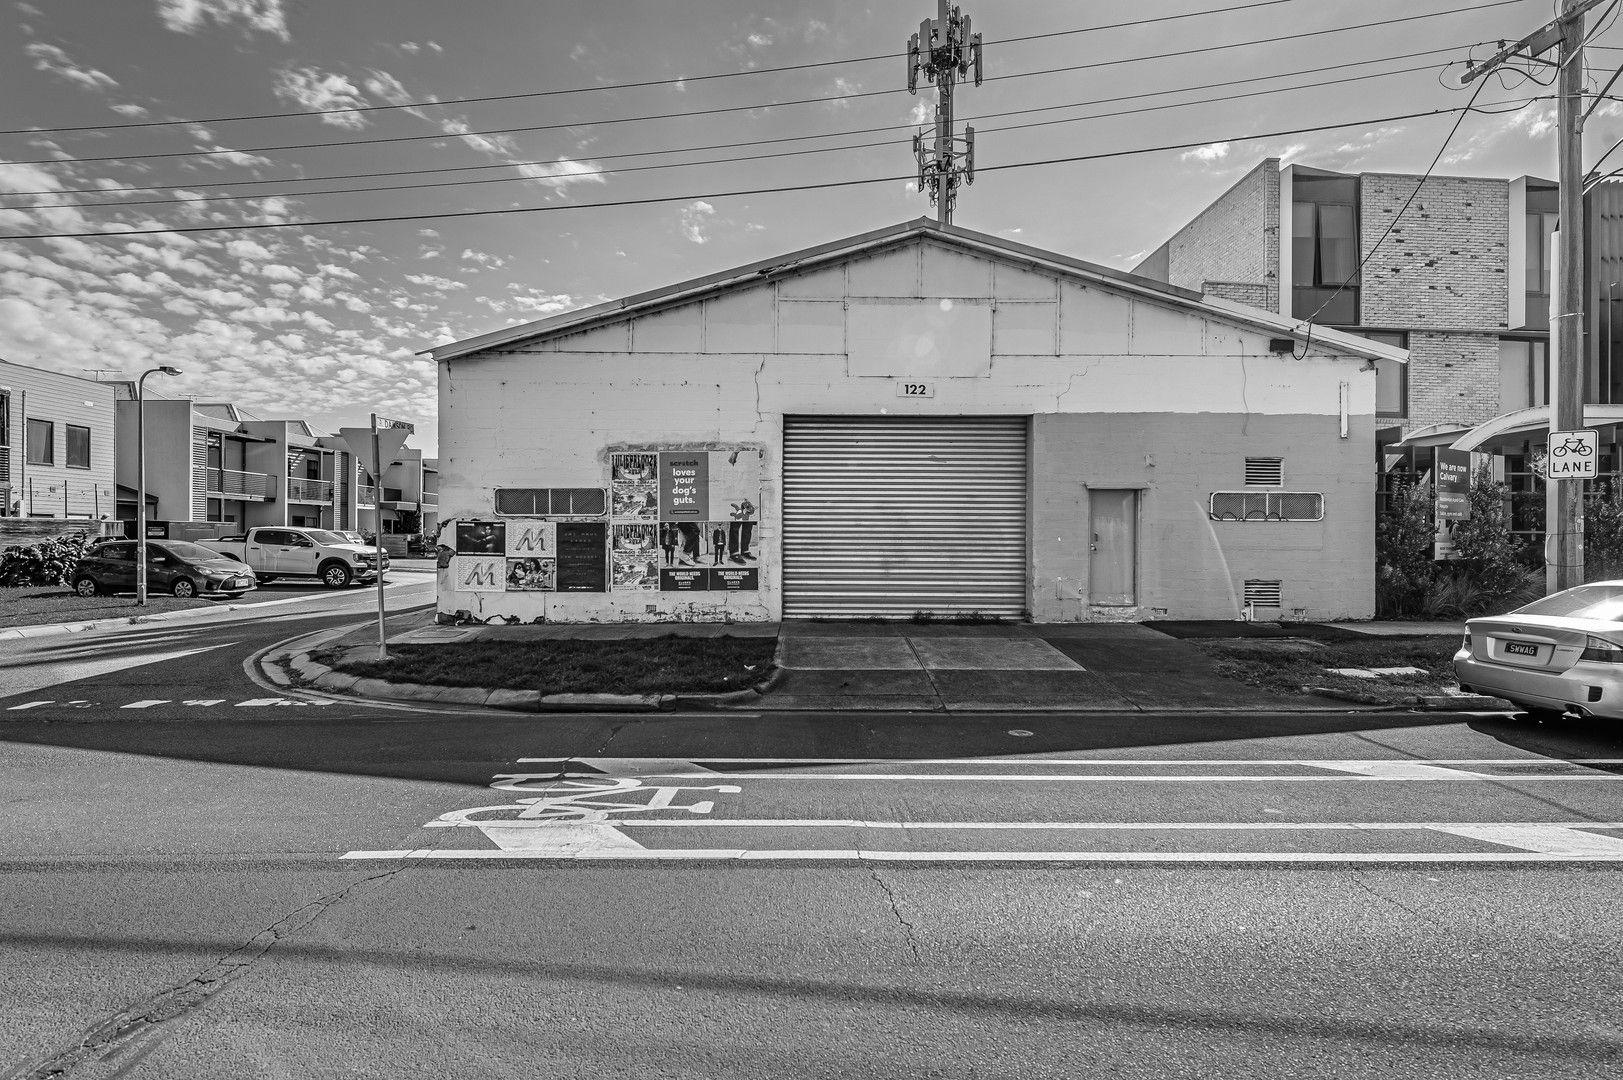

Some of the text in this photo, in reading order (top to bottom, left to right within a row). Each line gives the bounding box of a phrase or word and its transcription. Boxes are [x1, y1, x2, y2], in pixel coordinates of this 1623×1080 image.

[905, 384, 926, 395] 122
[672, 468, 696, 476] loves
[1439, 461, 1467, 473] We are now
[1553, 461, 1592, 473] LANE
[674, 477, 695, 486] your
[1439, 472, 1458, 483] Calvary
[672, 486, 697, 496] dog's
[673, 496, 696, 506] guts.
